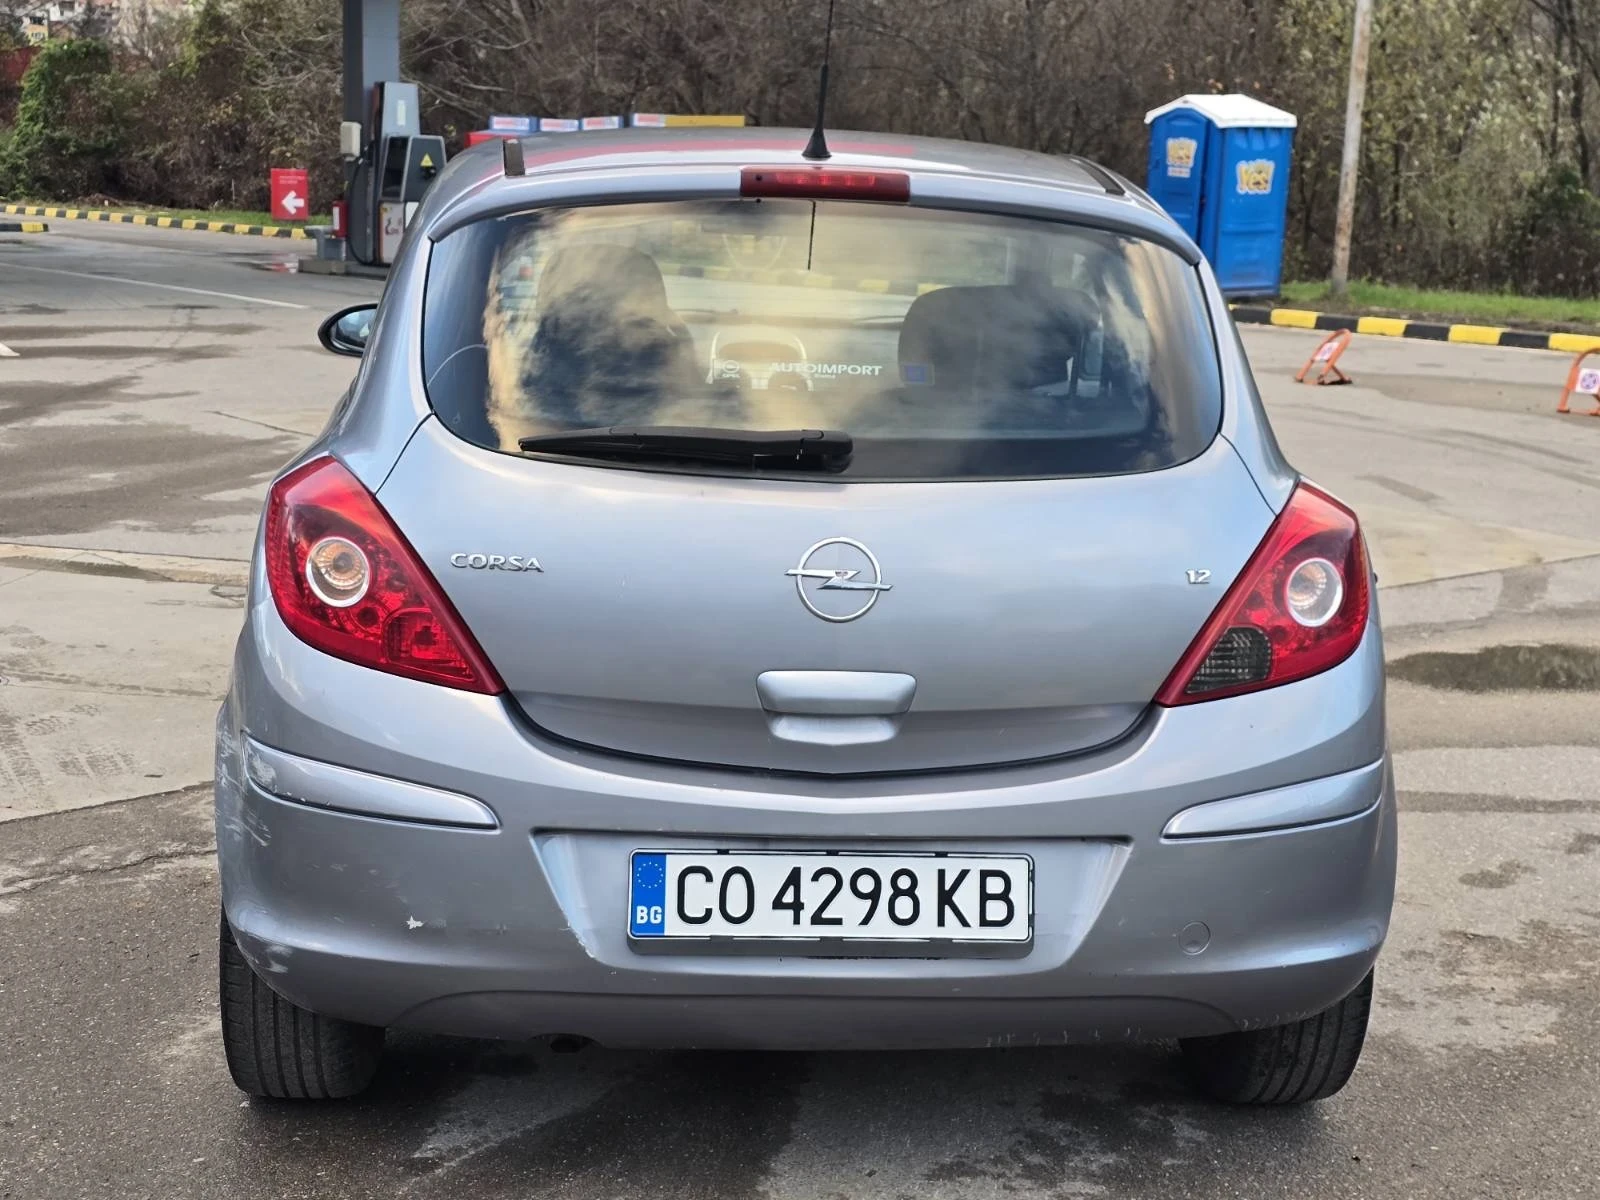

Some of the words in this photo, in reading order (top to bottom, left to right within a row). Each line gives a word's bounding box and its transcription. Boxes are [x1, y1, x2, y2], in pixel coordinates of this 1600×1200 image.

[769, 362, 883, 376] AUTOIMPORT
[450, 552, 544, 573] CORSA
[676, 865, 755, 925] CO
[771, 867, 921, 927] 4298
[936, 868, 1015, 928] KB
[635, 905, 663, 925] BG
